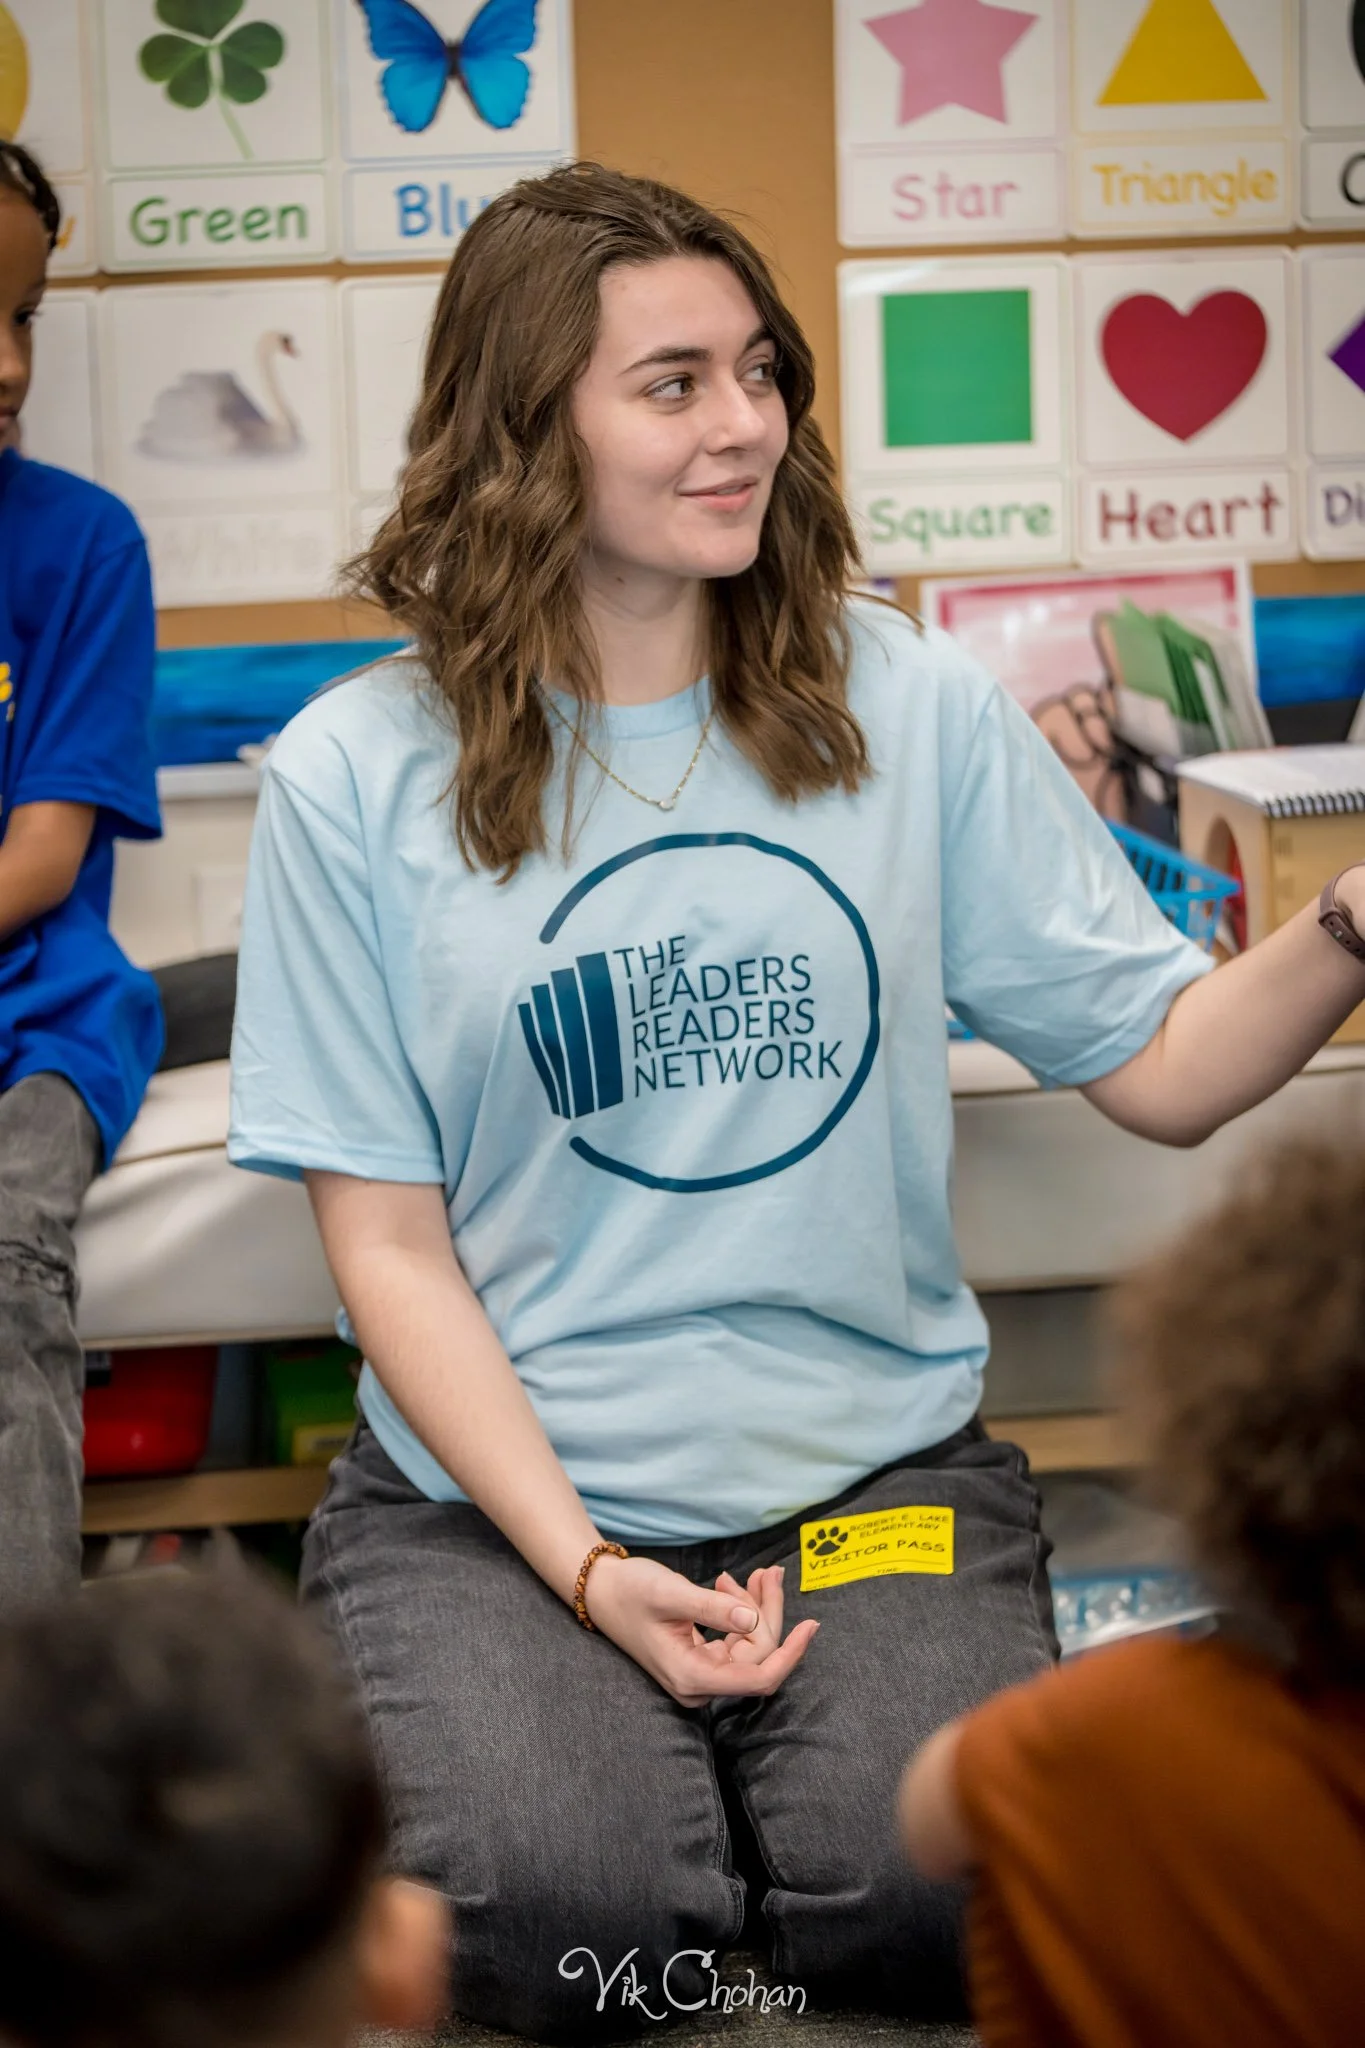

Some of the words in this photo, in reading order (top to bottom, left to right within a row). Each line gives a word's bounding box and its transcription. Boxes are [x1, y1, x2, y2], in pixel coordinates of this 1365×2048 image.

[893, 171, 1020, 222] Star
[1092, 158, 1278, 218] Triangle
[130, 197, 307, 247] Green
[868, 498, 1054, 555] Square
[1099, 481, 1282, 544] Heart
[613, 935, 686, 979] THE
[629, 954, 812, 1018] LEADERS
[633, 997, 815, 1058] READERS
[635, 1040, 844, 1097] NETWORK
[849, 1516, 896, 1532] ROBERT
[919, 1514, 950, 1523] LAKE
[809, 1543, 889, 1571] VISITOR
[897, 1539, 946, 1553] PASS
